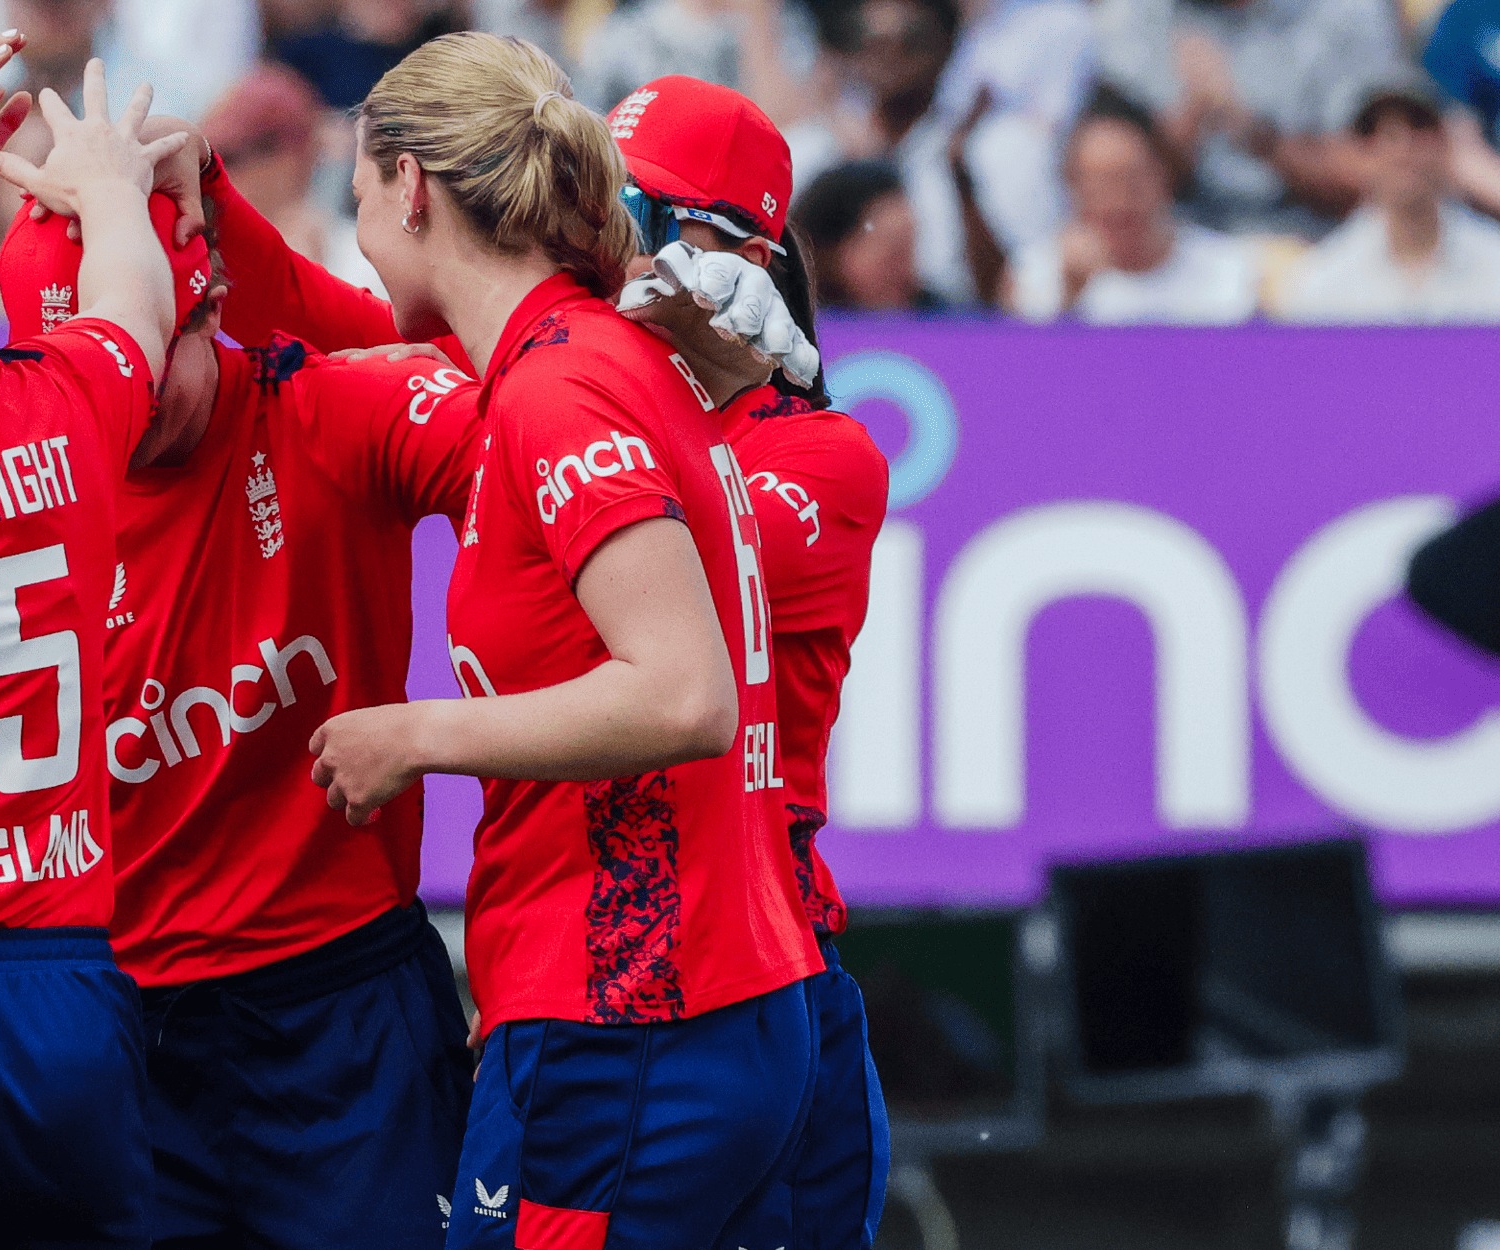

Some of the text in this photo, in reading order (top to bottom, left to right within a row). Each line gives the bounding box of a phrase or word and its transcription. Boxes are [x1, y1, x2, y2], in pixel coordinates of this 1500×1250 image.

[761, 191, 777, 218] 52
[189, 269, 207, 295] 33
[535, 430, 656, 525] cinch
[105, 635, 338, 784] cinch
